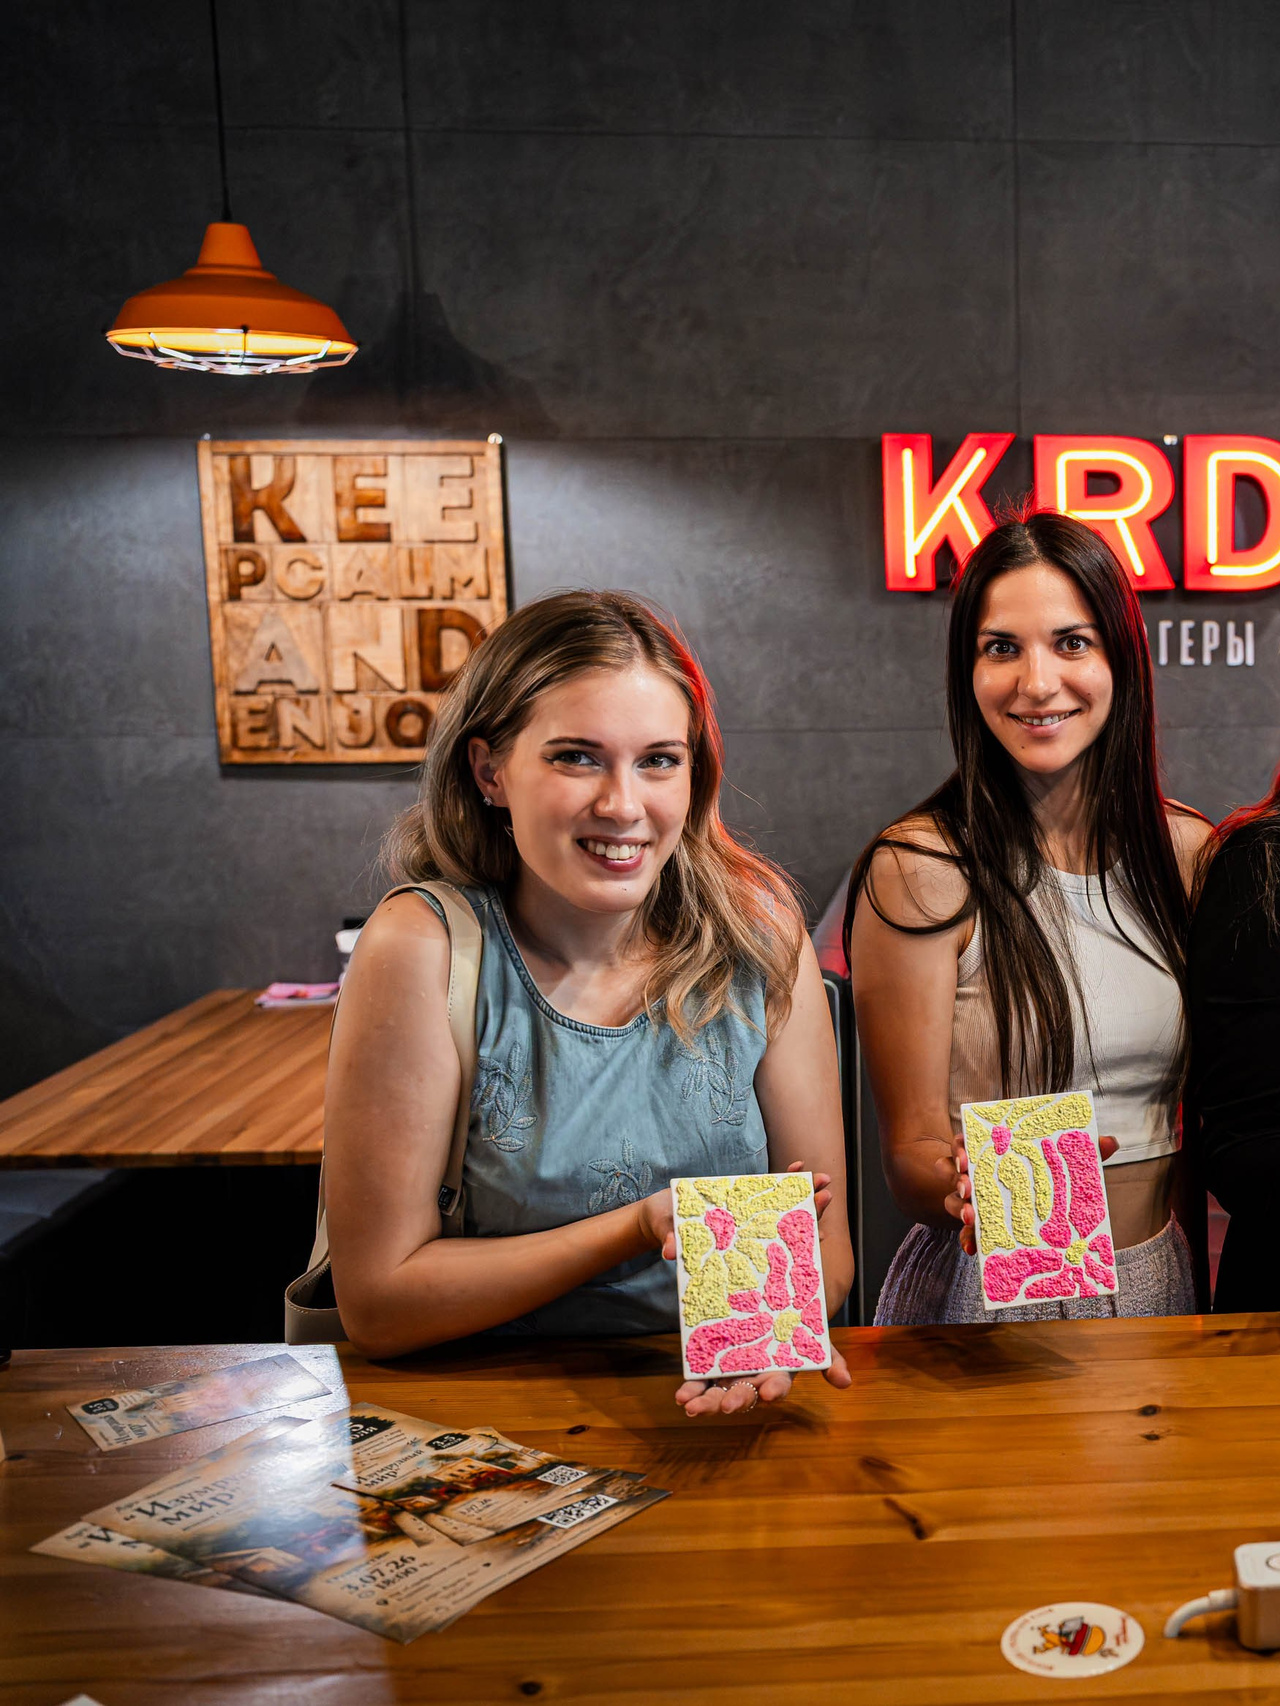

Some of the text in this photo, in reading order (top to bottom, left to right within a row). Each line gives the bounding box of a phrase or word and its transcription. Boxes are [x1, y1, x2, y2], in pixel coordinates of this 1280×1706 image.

[228, 454, 479, 543] KEE
[233, 604, 489, 694] AND
[1157, 619, 1255, 667] ГЕРЫ
[231, 692, 433, 750] ENJO
